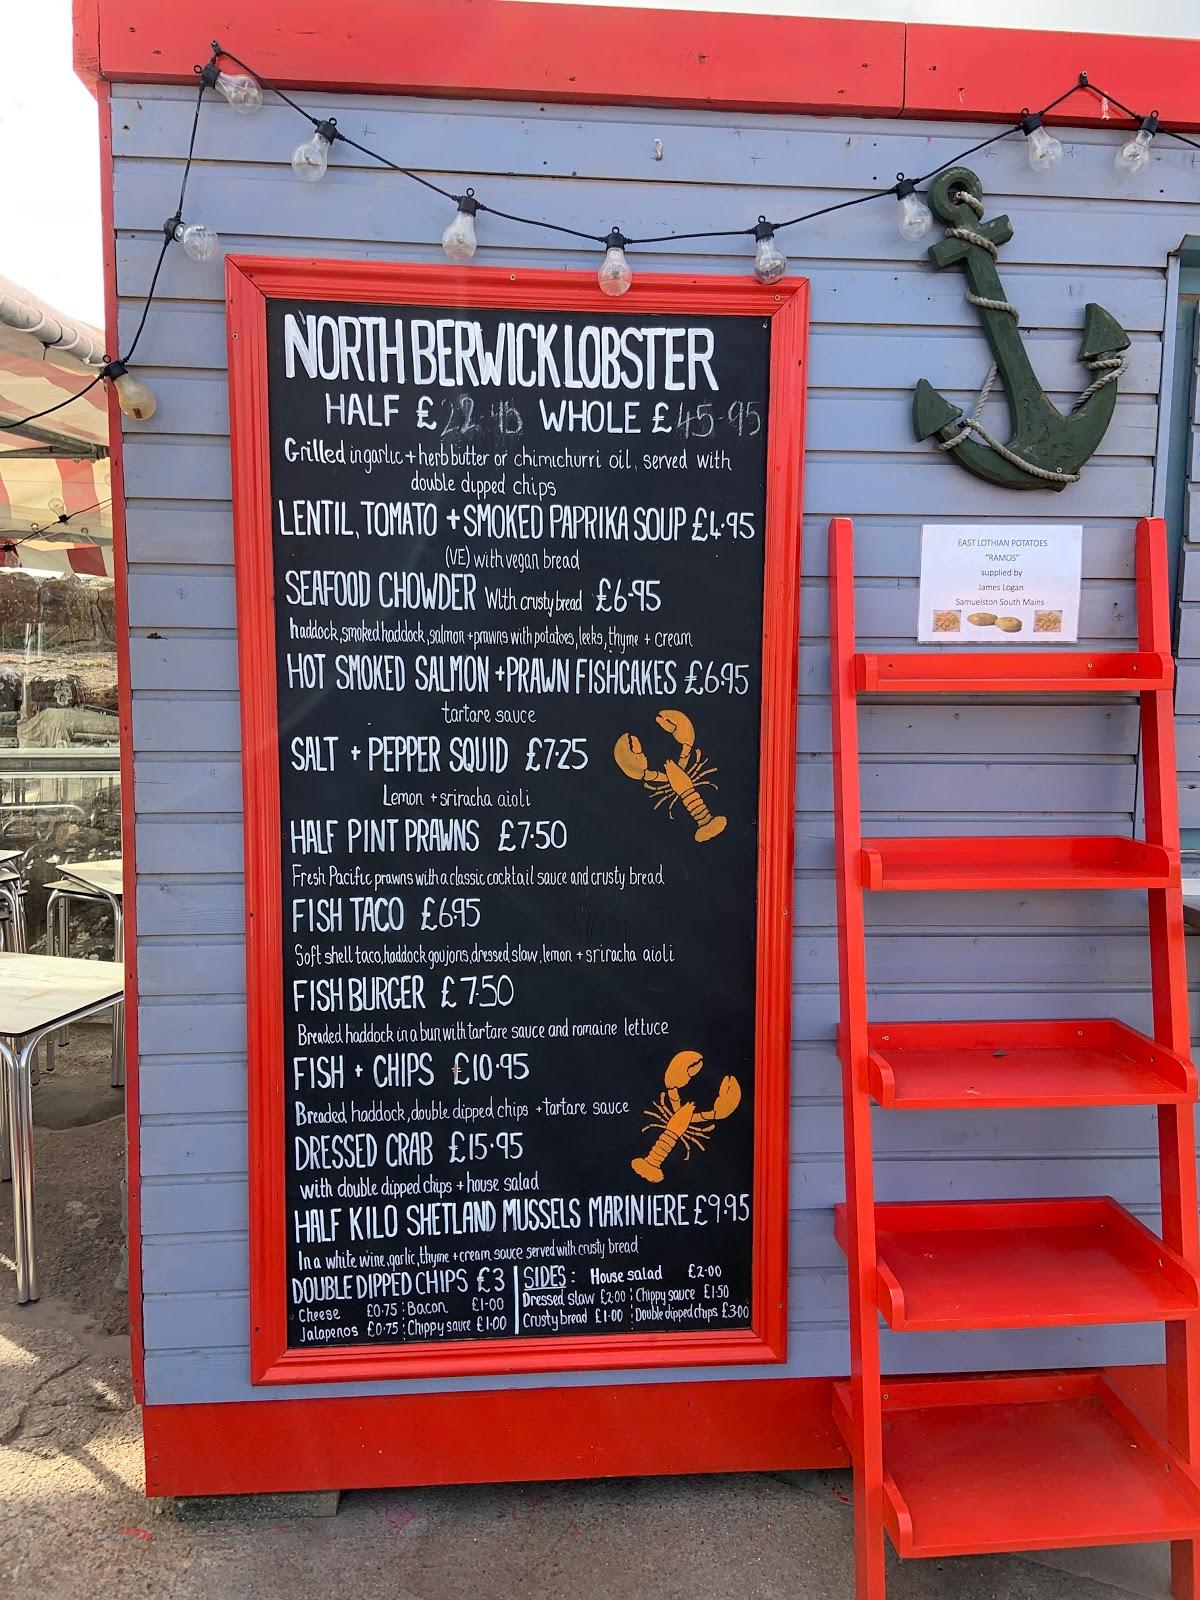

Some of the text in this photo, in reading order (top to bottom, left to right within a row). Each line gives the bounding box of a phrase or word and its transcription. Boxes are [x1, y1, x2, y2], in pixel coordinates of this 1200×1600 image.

[284, 314, 719, 391] NORTH BERWICK LOBSTER
[326, 393, 641, 434] HALF WHOLE
[284, 437, 732, 473] Grilled garlic butter or chimichurri oil, served with
[411, 470, 557, 501] double dipped chips
[279, 500, 359, 539] LENTIL,
[361, 502, 437, 536] TOMATO
[550, 504, 628, 541] PAPRIKA
[633, 507, 687, 541] SOUP
[1011, 539, 1048, 547] POTATOES
[445, 545, 580, 573] (VE) with vegan bread
[981, 569, 1022, 577] supplied by
[285, 570, 371, 607] SEAFOOD
[379, 571, 476, 611] CHOWDER
[520, 590, 554, 617] crusty
[556, 590, 583, 612] bread
[955, 598, 1044, 606] Samuelston South Mains
[978, 583, 1024, 592] James Logan
[655, 631, 693, 647] cream
[287, 653, 326, 689] HOT
[335, 654, 405, 691] SMOKED
[415, 655, 489, 692] SALMON
[575, 658, 677, 695] FISHCAKES
[441, 701, 536, 724] tartare sauce
[291, 736, 338, 772] SALT
[368, 736, 441, 773] PEPPER
[449, 737, 509, 773] SQUID
[383, 784, 531, 808] Lemon sriracha aioli
[290, 819, 338, 854] HALF
[348, 819, 399, 853] PINT
[405, 819, 480, 852] PRAWNS
[292, 864, 326, 887] Fresh
[329, 865, 373, 887] Pacific
[375, 872, 414, 891] prawns
[487, 865, 534, 886] cocktail
[537, 871, 567, 885] sauce
[570, 866, 589, 885] and
[591, 866, 625, 890] crusty
[629, 864, 665, 885] bread
[292, 898, 343, 933] FISH
[349, 896, 404, 932] TACO
[295, 944, 321, 967] Soft
[324, 945, 353, 965] shell
[586, 943, 637, 963] sriracha
[643, 944, 675, 963] aioli
[293, 975, 426, 1012] FISH BURGER
[297, 1023, 343, 1046] Breaded
[345, 1023, 394, 1044] haddock
[467, 1021, 508, 1039] tartare
[511, 1024, 545, 1039] sauce
[548, 1018, 569, 1038] and
[572, 1021, 618, 1037] romaine
[624, 1017, 669, 1037] lettuce
[293, 1054, 344, 1090] FISH
[373, 1052, 435, 1088] CHIPS
[295, 1101, 347, 1126] Breaded
[452, 1096, 495, 1123] dipped
[497, 1098, 528, 1122] chips
[593, 1100, 630, 1116] sauce
[295, 1133, 377, 1171] DRESSED
[386, 1131, 433, 1168] CRAB
[300, 1170, 539, 1200] with double dipped chips house salad
[294, 1208, 342, 1244] HALF
[349, 1204, 398, 1241] KILO
[406, 1200, 496, 1236] SHETLAND
[502, 1197, 580, 1232] MUSSELS
[589, 1194, 689, 1228] MARINIERE
[326, 1252, 358, 1269] white
[494, 1247, 523, 1260] sauce
[526, 1240, 555, 1259] served
[578, 1239, 605, 1259] crusty
[608, 1235, 639, 1254] bread
[291, 1275, 353, 1304] DOUBLE
[356, 1271, 412, 1300] DIPPED
[415, 1268, 469, 1295] CHIPS
[590, 1268, 624, 1285] House
[627, 1265, 663, 1281] salad
[407, 1301, 449, 1316] Bacon
[522, 1292, 565, 1308] Dressed
[635, 1288, 665, 1308] Chippy
[668, 1287, 695, 1300] sauce
[298, 1308, 341, 1323] Cheese
[407, 1320, 444, 1338] Chippy
[446, 1319, 471, 1332] sauce
[523, 1311, 559, 1331] Crusty
[559, 1308, 588, 1325] bread
[300, 1325, 359, 1343] Jalapenos
